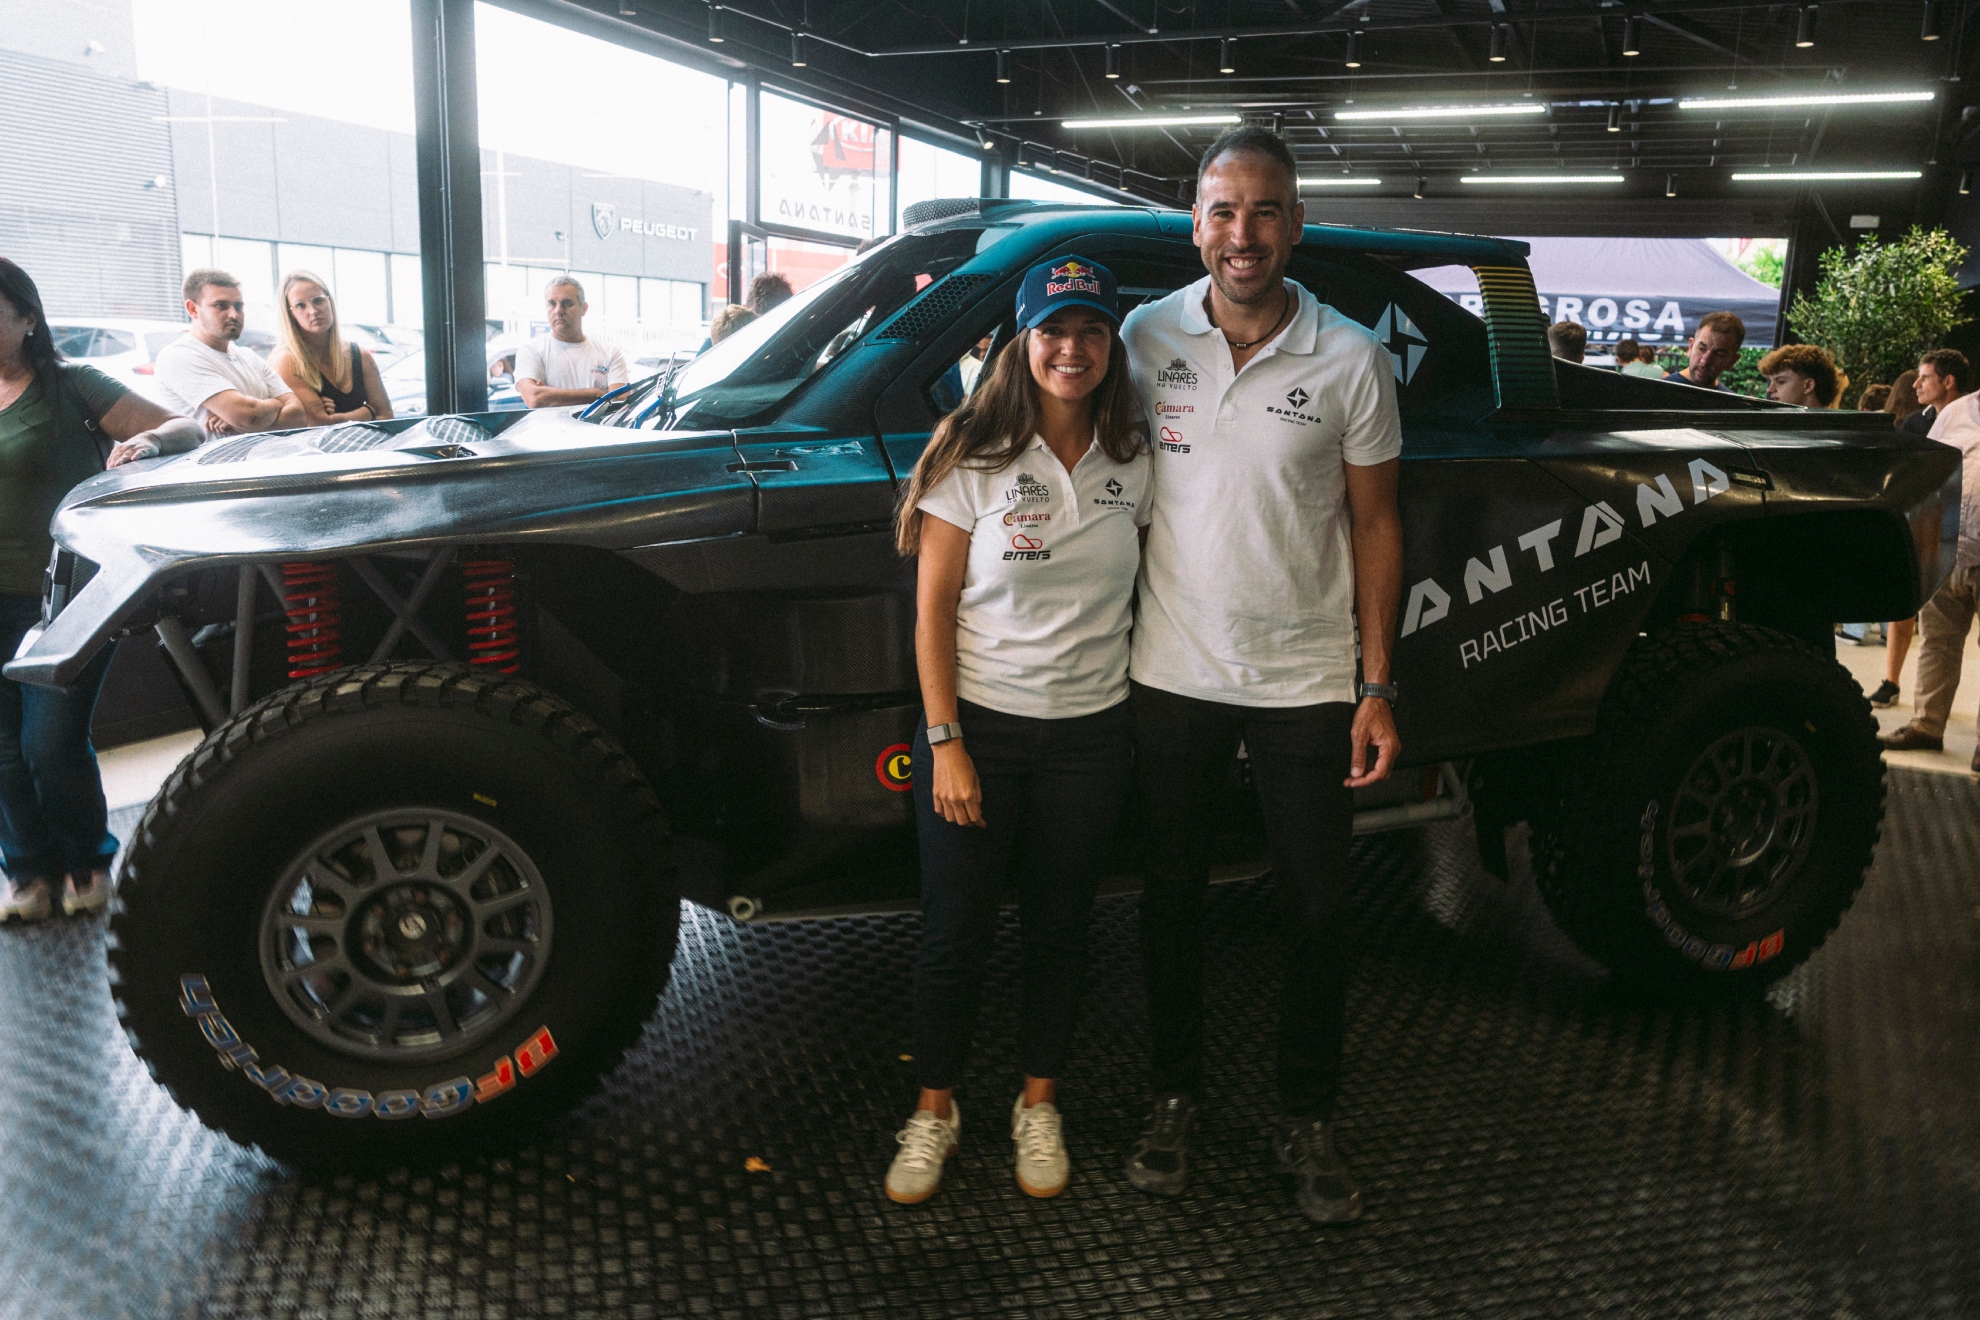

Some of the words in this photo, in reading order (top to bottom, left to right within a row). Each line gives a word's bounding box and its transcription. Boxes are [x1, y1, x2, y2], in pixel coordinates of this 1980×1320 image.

[619, 217, 698, 241] PEUGEOT
[1047, 278, 1074, 296] Red
[1075, 278, 1101, 296] Bull
[1157, 370, 1198, 385] LINARES
[1169, 383, 1198, 391] VUELTO
[1155, 401, 1195, 416] Cámara
[1266, 406, 1322, 423] SANTANA
[1005, 485, 1049, 501] LINARES
[1093, 498, 1135, 508] SANTANA
[1003, 511, 1051, 526] Cámara
[1352, 458, 1730, 660] ANTANA
[1460, 598, 1568, 668] RACING
[1574, 561, 1651, 613] TEAM
